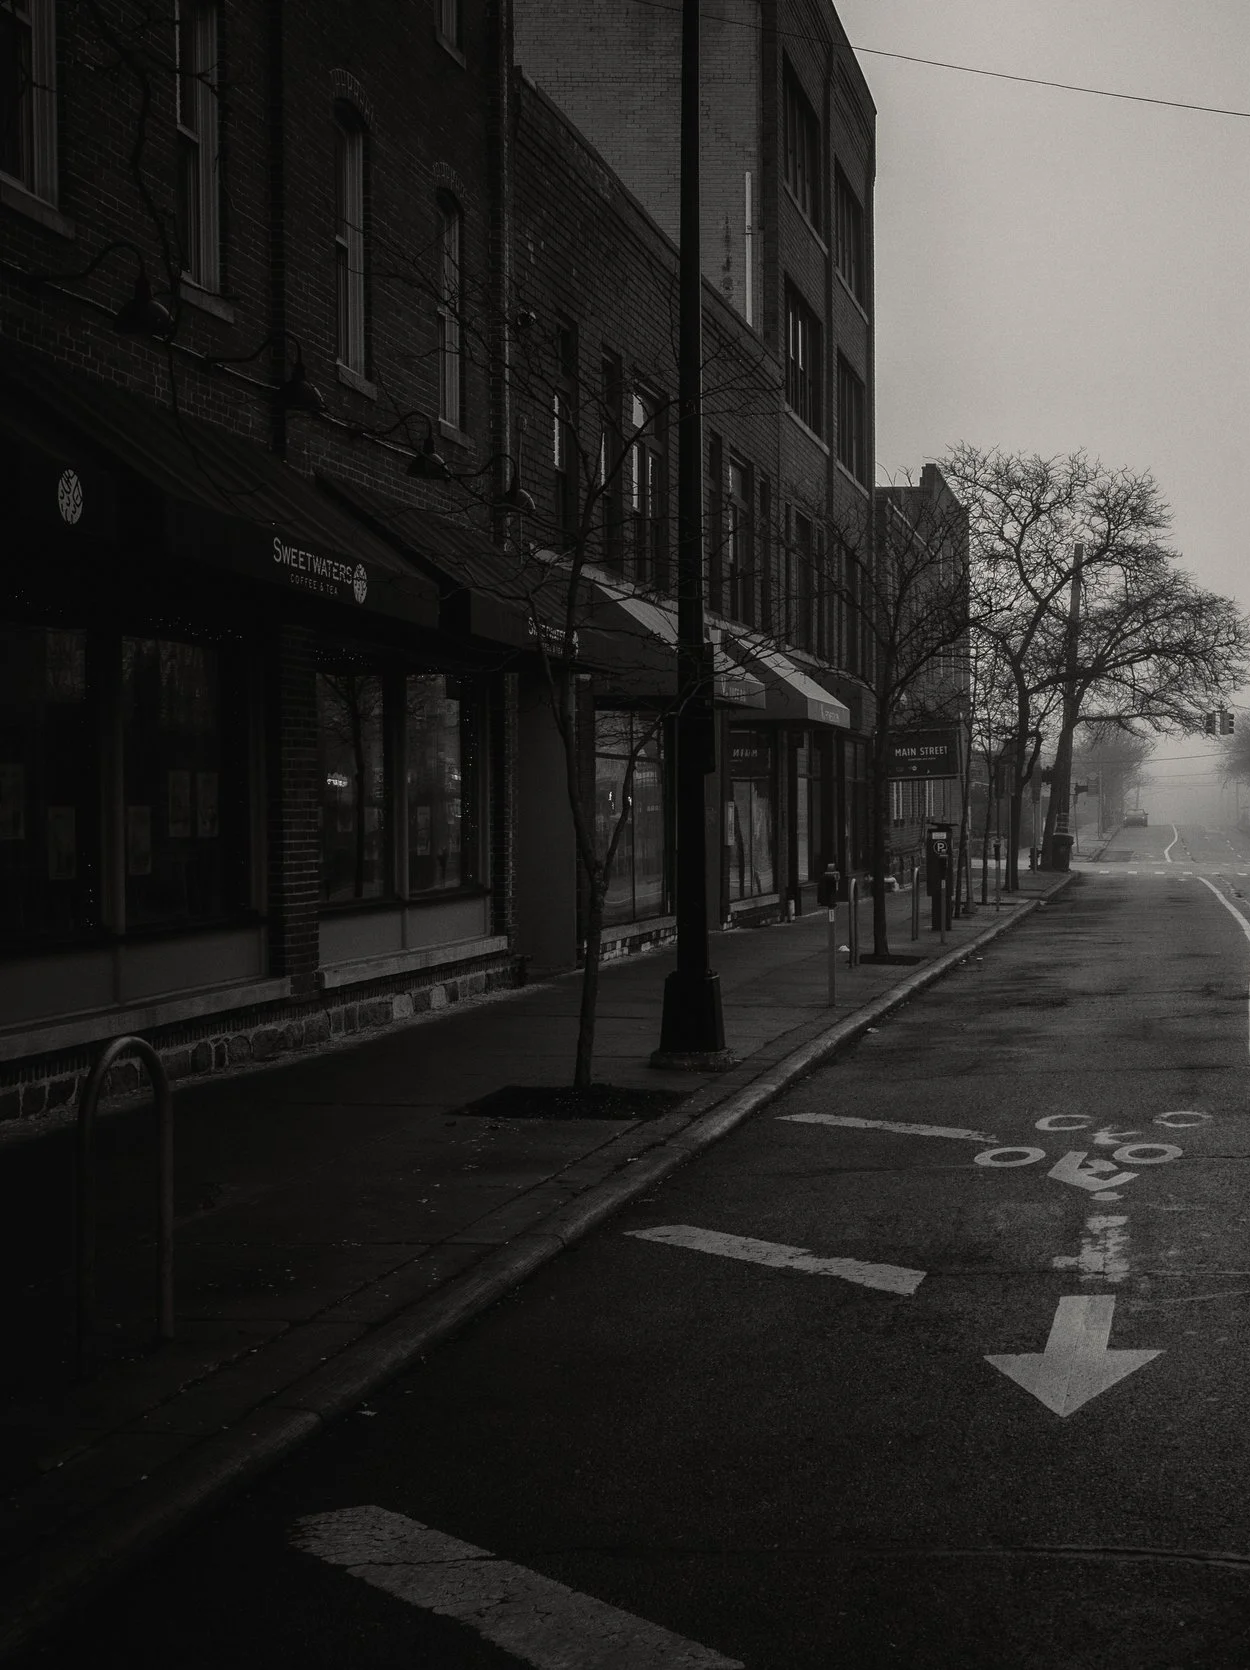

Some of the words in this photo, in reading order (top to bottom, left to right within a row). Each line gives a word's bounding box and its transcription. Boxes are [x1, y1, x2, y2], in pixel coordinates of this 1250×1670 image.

[273, 536, 353, 585] SWEETWATERS
[290, 573, 317, 590] COFFEE
[326, 583, 339, 596] TEA
[895, 748, 917, 757] MAIN
[920, 746, 948, 756] STREET
